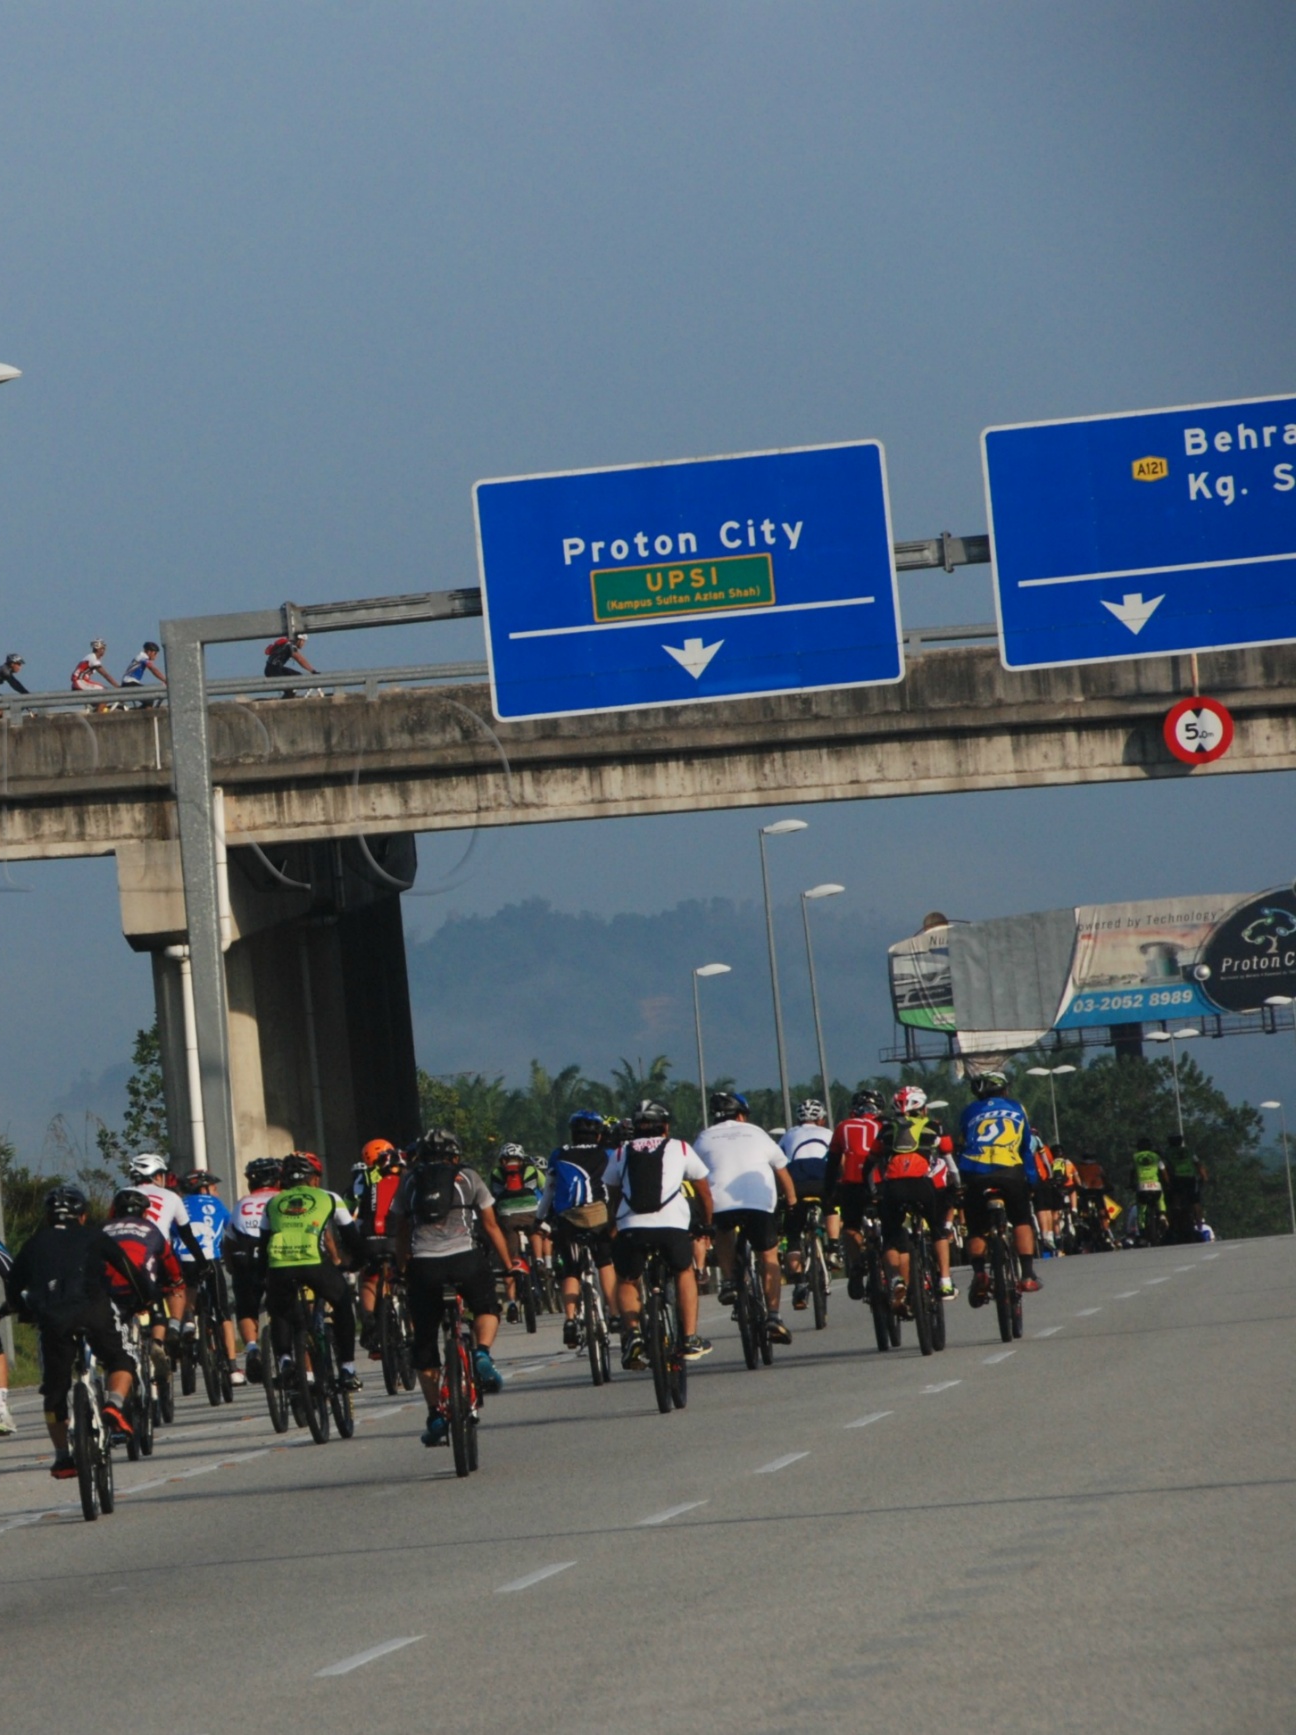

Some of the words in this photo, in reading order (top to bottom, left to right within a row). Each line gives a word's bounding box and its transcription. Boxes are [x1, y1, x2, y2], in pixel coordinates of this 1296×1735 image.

[1184, 423, 1296, 456] Behra
[1137, 462, 1164, 476] A121
[1188, 472, 1248, 506] Kg.
[1273, 463, 1296, 491] S
[563, 531, 697, 565] Proton
[720, 518, 803, 549] City
[646, 566, 718, 592] UPSI
[607, 599, 653, 612] (Kampus
[656, 594, 691, 606] Sultan
[695, 590, 725, 602] Azlan
[729, 585, 761, 598] Shah)
[1078, 918, 1121, 931] owered
[1127, 917, 1141, 928] by
[1147, 911, 1217, 925] Technology
[1221, 955, 1281, 973] Proton
[1284, 951, 1296, 966] C
[1073, 994, 1143, 1013] 03-2052
[1149, 989, 1194, 1007] 8989
